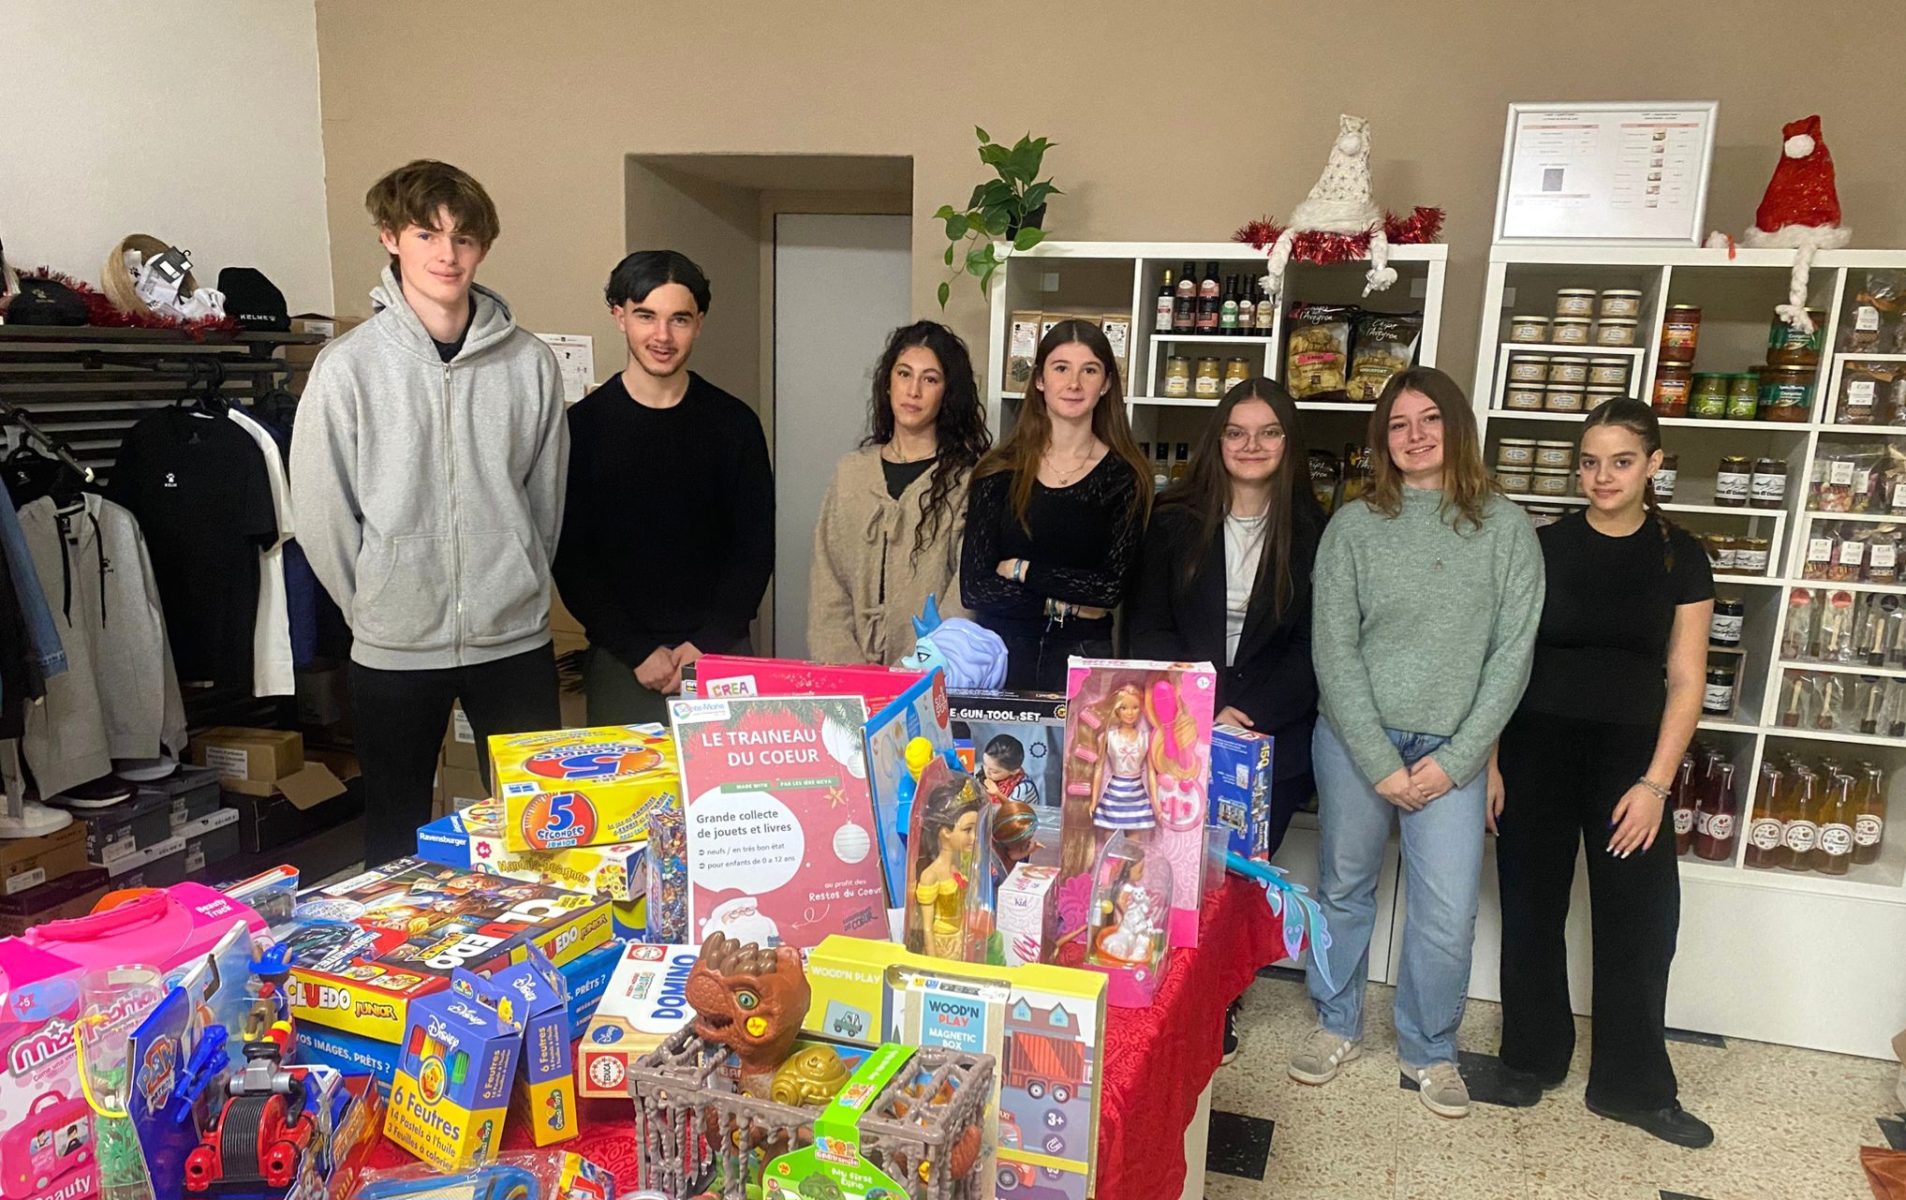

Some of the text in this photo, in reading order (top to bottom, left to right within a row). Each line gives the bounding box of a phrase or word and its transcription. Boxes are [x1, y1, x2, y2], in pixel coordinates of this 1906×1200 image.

[711, 682, 750, 697] CREA
[960, 708, 984, 720] GUN
[987, 709, 1016, 722] TOOL
[1019, 711, 1042, 722] SET
[702, 729, 816, 748] LE TRAINEAU
[727, 749, 820, 766] DU COEUR
[1260, 742, 1270, 769] 150
[559, 752, 625, 780] 5
[546, 793, 576, 832] 5
[696, 810, 779, 824] Grande collecte
[419, 832, 467, 847] Ravensburger
[537, 826, 585, 840] SECONDES
[697, 823, 792, 840] de jouets et livres
[546, 839, 577, 849] JUNIOR
[707, 847, 726, 856] neufs
[756, 843, 770, 851] bon
[707, 862, 724, 870] pour
[725, 858, 751, 868] enfants
[752, 857, 761, 865] de
[775, 855, 783, 863] 12
[835, 879, 854, 889] profit
[809, 886, 882, 902] Restos du Coeur
[195, 899, 228, 913] Beauty
[204, 904, 233, 919] Truck
[425, 899, 568, 970] CLUEDO
[810, 965, 881, 985] WOOD'N PLAY
[575, 974, 606, 998] PRÊTS ?
[651, 954, 698, 1020] DOMINO
[283, 975, 398, 1021] CLUEDO JUNIOR
[929, 1000, 980, 1019] WOOD'N
[938, 1013, 969, 1027] PLAY
[427, 1014, 460, 1051] Disney
[928, 1027, 977, 1043] MAGNETIC
[538, 1026, 549, 1073] 6 Feutres
[942, 1039, 963, 1050] BOX
[314, 1038, 353, 1061] IMAGES,
[353, 1052, 383, 1071] PRÊTS
[384, 1063, 391, 1074] ?
[483, 1050, 501, 1100] 6 Feutres
[603, 1061, 612, 1082] EDUCA
[393, 1085, 460, 1142] 6 Feutres
[999, 1110, 1010, 1120] AXI
[1047, 1112, 1065, 1126] 3+
[387, 1123, 393, 1133] 3
[393, 1127, 418, 1154] Feuilles
[419, 1143, 425, 1154] à
[389, 1107, 456, 1157] 14 Pastels à l'huile
